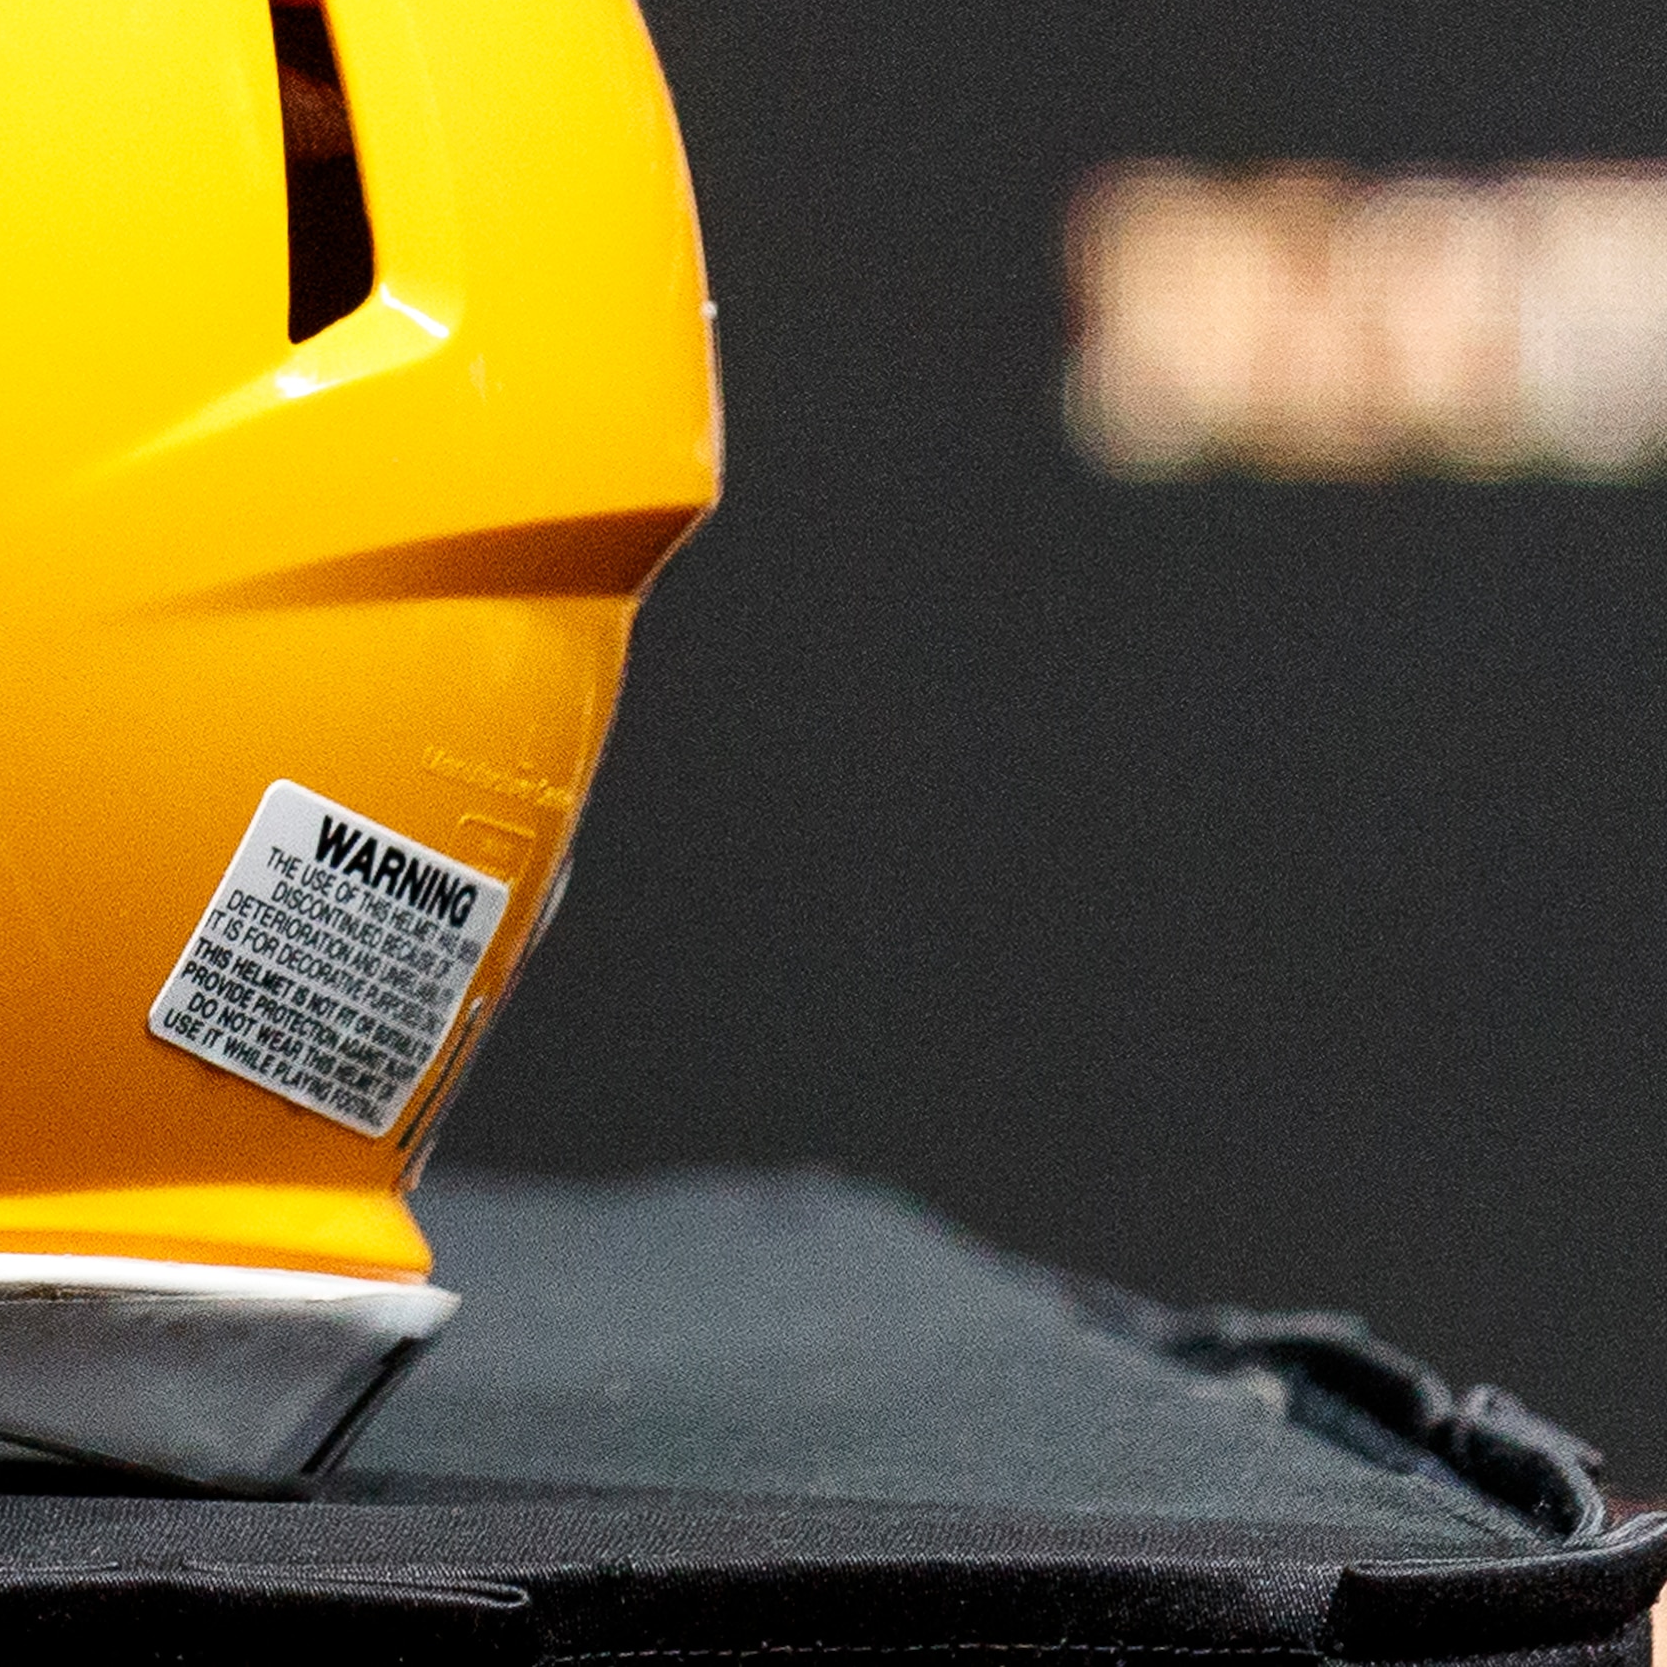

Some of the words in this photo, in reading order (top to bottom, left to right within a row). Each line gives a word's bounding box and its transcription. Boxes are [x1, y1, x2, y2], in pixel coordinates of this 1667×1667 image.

[267, 846, 302, 880] THE
[300, 865, 337, 896] USE
[334, 881, 360, 904] OF
[359, 891, 392, 923] THIS
[391, 909, 439, 942] HELMET
[272, 881, 383, 948] DISCONTINUED
[316, 815, 476, 927] WARNING
[205, 909, 226, 931] IT
[222, 917, 244, 942] IS
[241, 926, 280, 959] FOR
[276, 944, 366, 1000] DECORATIVE
[227, 890, 353, 963] DETERIORATION
[350, 951, 381, 978] AND
[182, 961, 255, 1009] PROVIDE
[253, 995, 339, 1049] PROTECTION
[194, 937, 233, 970] THIS
[231, 957, 295, 997] HELMET
[291, 986, 310, 1007] IS
[306, 993, 339, 1018] NOT
[335, 1006, 357, 1027] FIT
[163, 1009, 204, 1041] USE
[201, 1027, 224, 1048] IT
[223, 1037, 274, 1074] WHILE
[272, 1061, 332, 1101] PLAYING
[187, 991, 218, 1019] DO
[216, 1006, 257, 1036] NOT
[256, 1025, 303, 1060] WEAR
[303, 1045, 337, 1075] THIS
